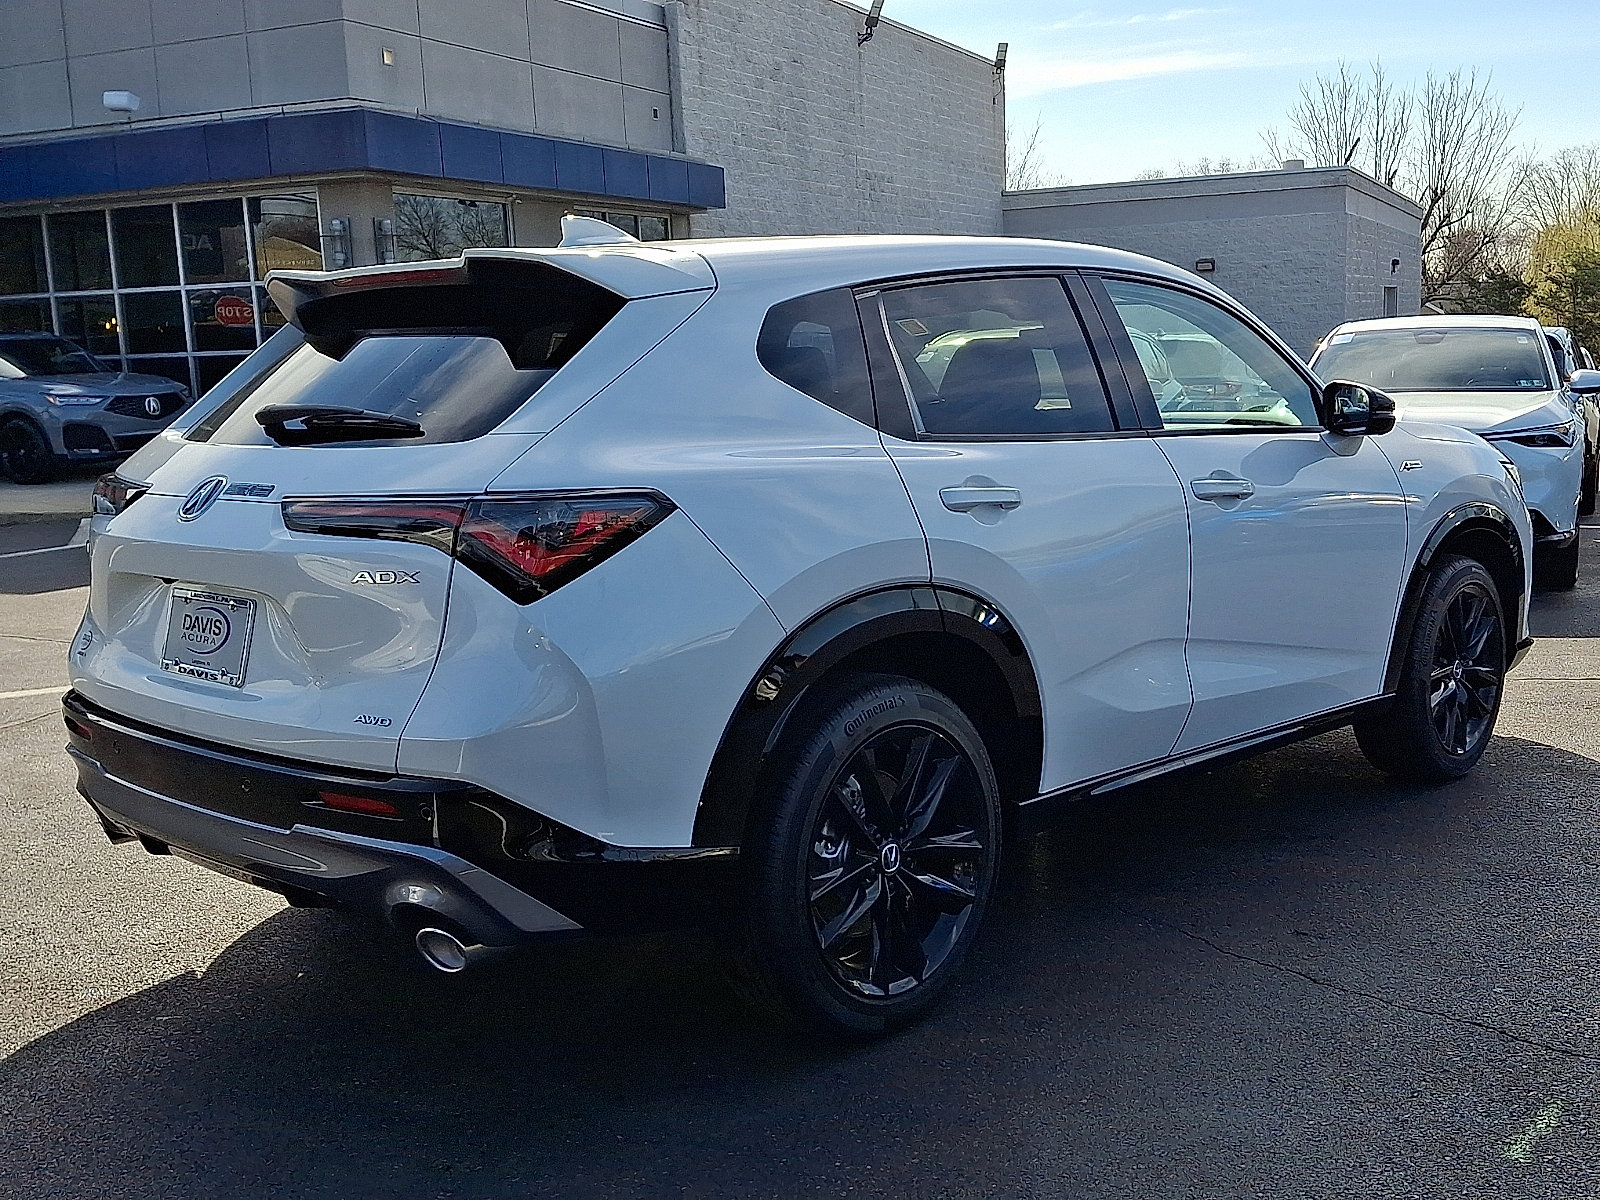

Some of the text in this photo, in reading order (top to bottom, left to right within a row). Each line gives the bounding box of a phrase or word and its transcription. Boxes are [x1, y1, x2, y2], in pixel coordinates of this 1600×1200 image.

[351, 570, 421, 584] ADX
[182, 613, 223, 637] DAVIS
[180, 631, 217, 646] ACURA
[177, 665, 219, 681] DAVIS
[353, 714, 393, 728] AWD
[843, 695, 898, 737] Continental
